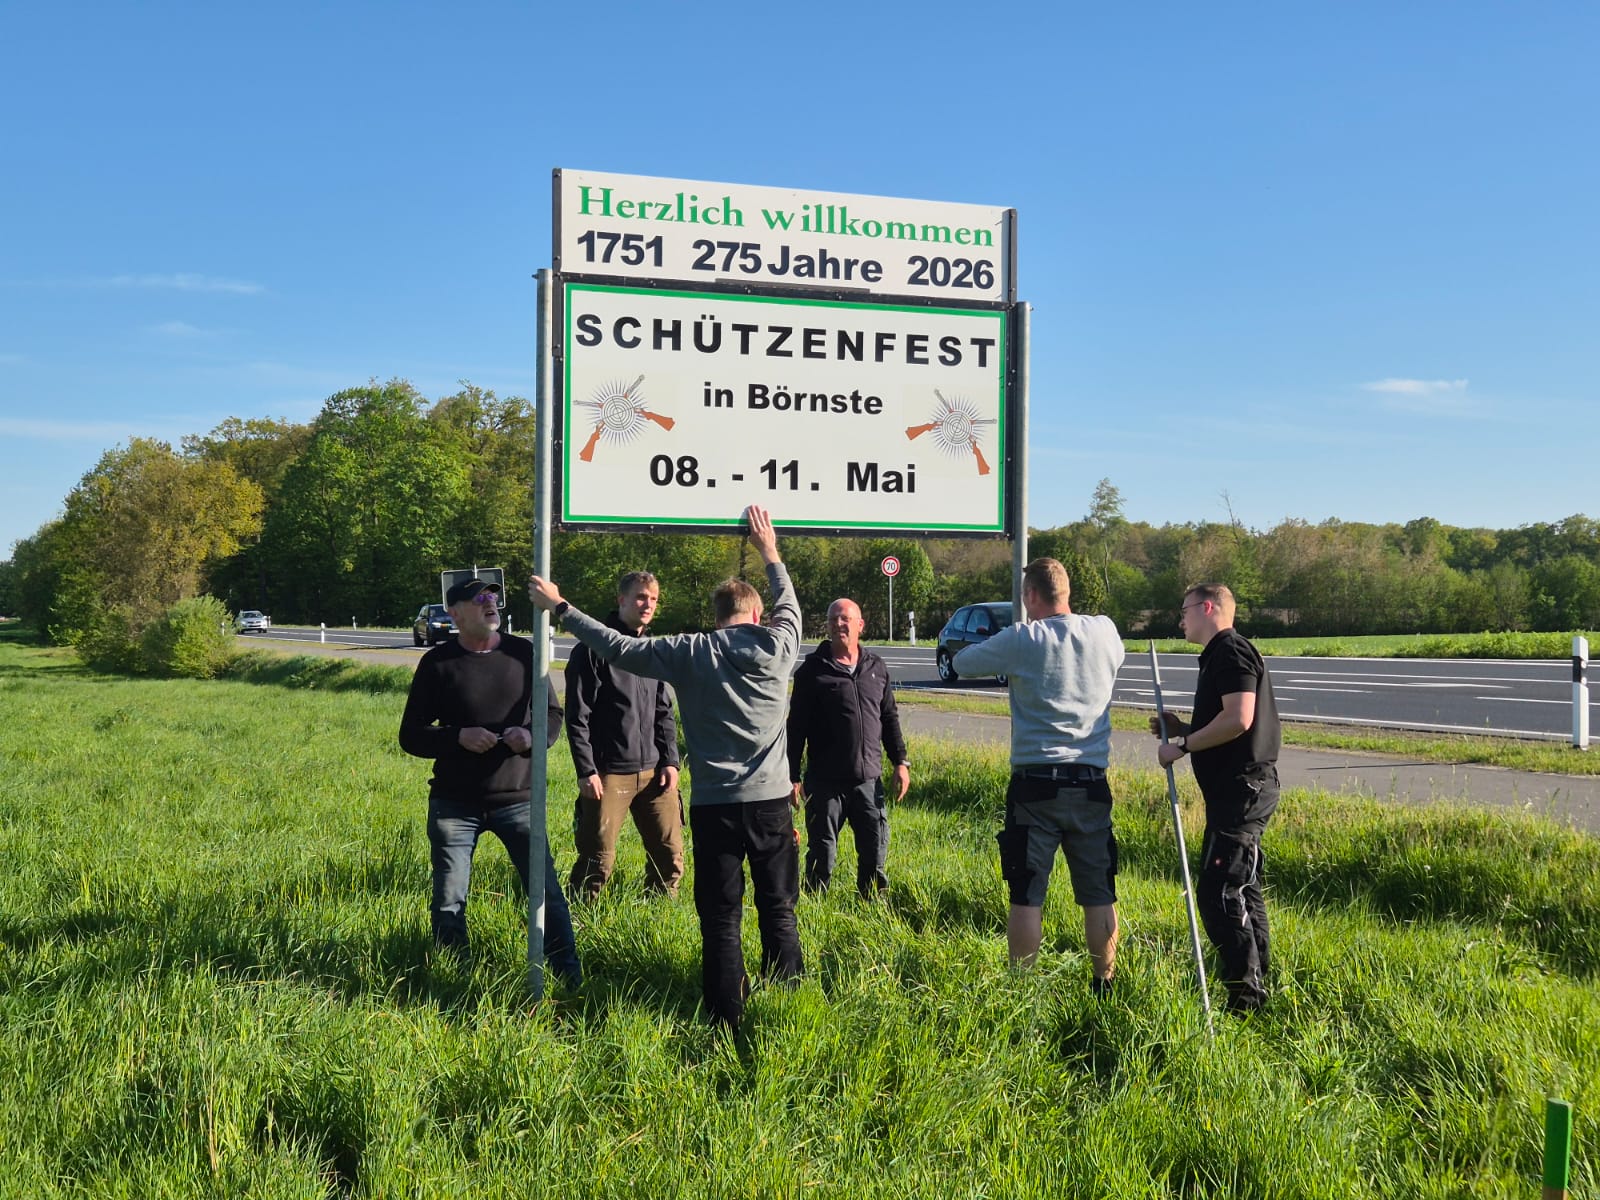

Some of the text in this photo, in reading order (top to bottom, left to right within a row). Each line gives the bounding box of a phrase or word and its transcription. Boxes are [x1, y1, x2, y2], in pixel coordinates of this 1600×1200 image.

[578, 185, 994, 247] Herzlich willkommen
[577, 229, 995, 290] 1751 275 Jahre 2026
[575, 313, 996, 368] SCHÜTZENFEST
[703, 381, 883, 415] in Börnste
[649, 454, 716, 488] 08.
[760, 458, 820, 492] 11.
[846, 461, 916, 494] Mai
[886, 562, 896, 571] 70
